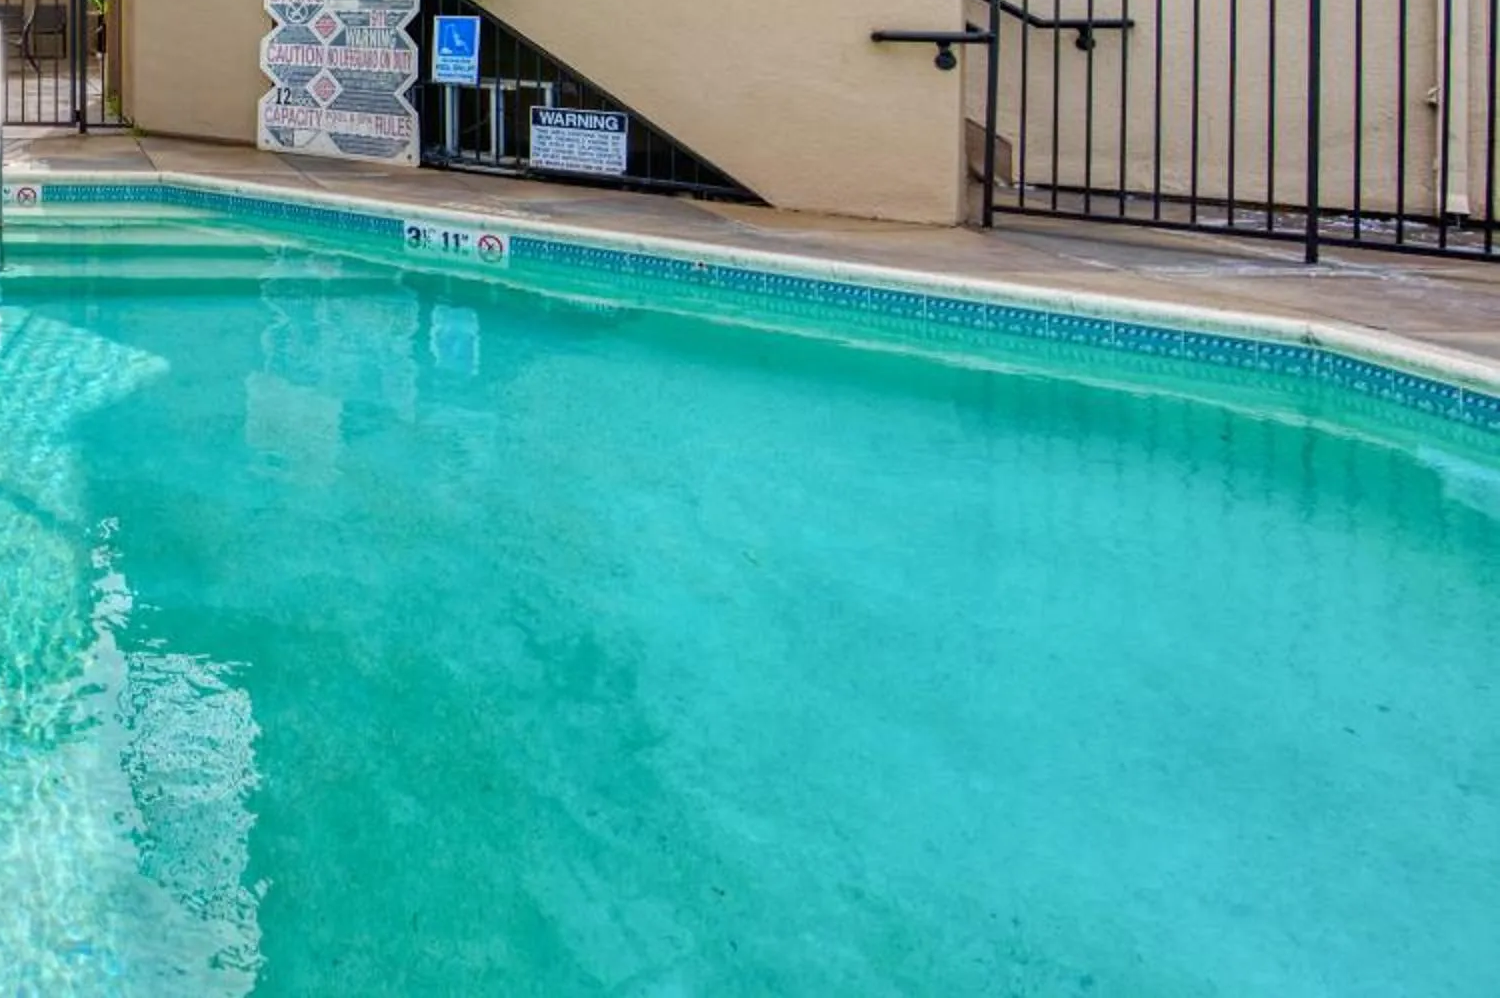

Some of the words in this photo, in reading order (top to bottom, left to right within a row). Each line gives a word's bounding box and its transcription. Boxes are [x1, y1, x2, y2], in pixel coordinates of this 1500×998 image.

[267, 44, 324, 65] CAUTION
[276, 87, 292, 105] 12
[264, 107, 323, 129] CAPACITY
[374, 116, 413, 138] RULES
[539, 111, 619, 131] WARNING
[441, 231, 460, 253] 11
